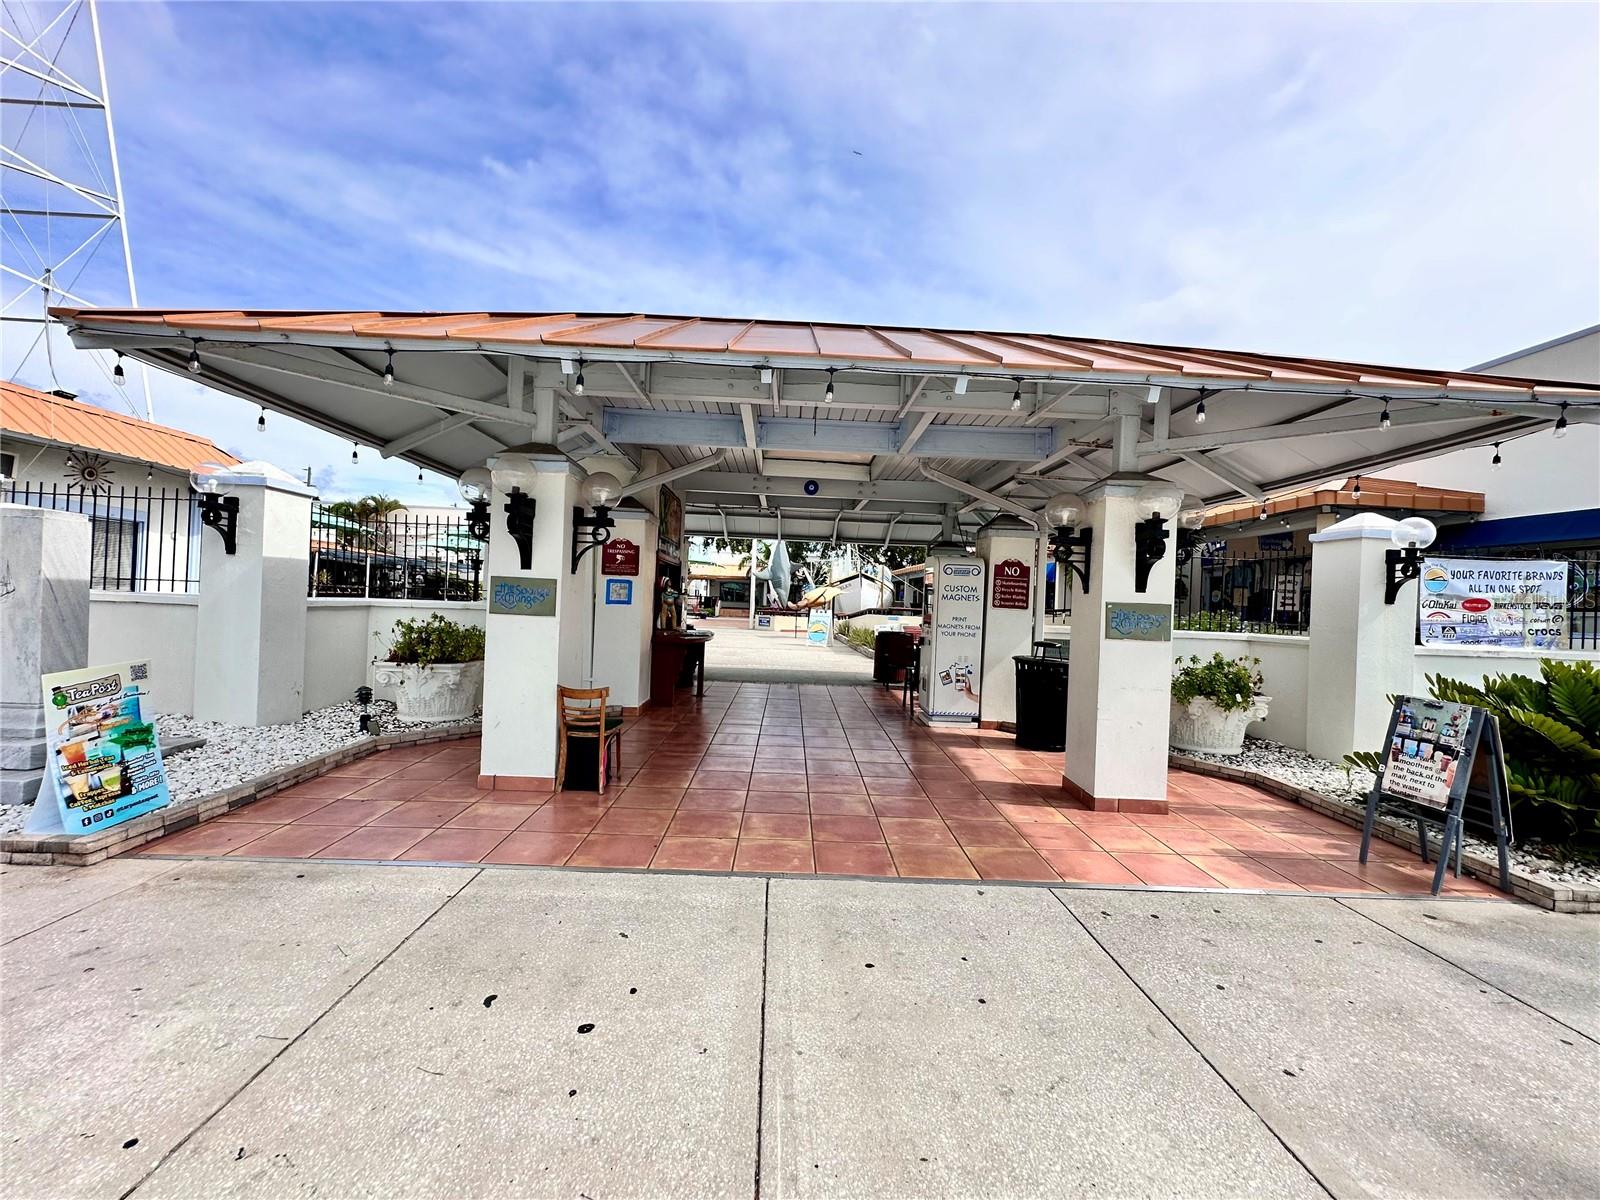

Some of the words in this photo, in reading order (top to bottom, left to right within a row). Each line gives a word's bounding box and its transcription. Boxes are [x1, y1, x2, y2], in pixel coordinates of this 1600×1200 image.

[1004, 566, 1020, 576] NO
[1450, 570, 1475, 580] YOUR
[1478, 570, 1523, 581] FAVORITE
[1526, 571, 1564, 580] BRANDS
[943, 584, 978, 593] CUSTOM
[1469, 584, 1482, 593] ALL
[1485, 585, 1496, 593] IN
[1499, 585, 1516, 593] ONE
[1519, 584, 1542, 594] SPOT
[941, 594, 980, 602] MAGNETS
[1527, 628, 1562, 637] crocs
[1393, 764, 1404, 772] the
[1406, 767, 1424, 778] back
[1435, 775, 1447, 783] the
[138, 777, 158, 791] MORE
[1389, 779, 1401, 787] the
[1402, 784, 1422, 793] water
[1409, 777, 1426, 787] next
